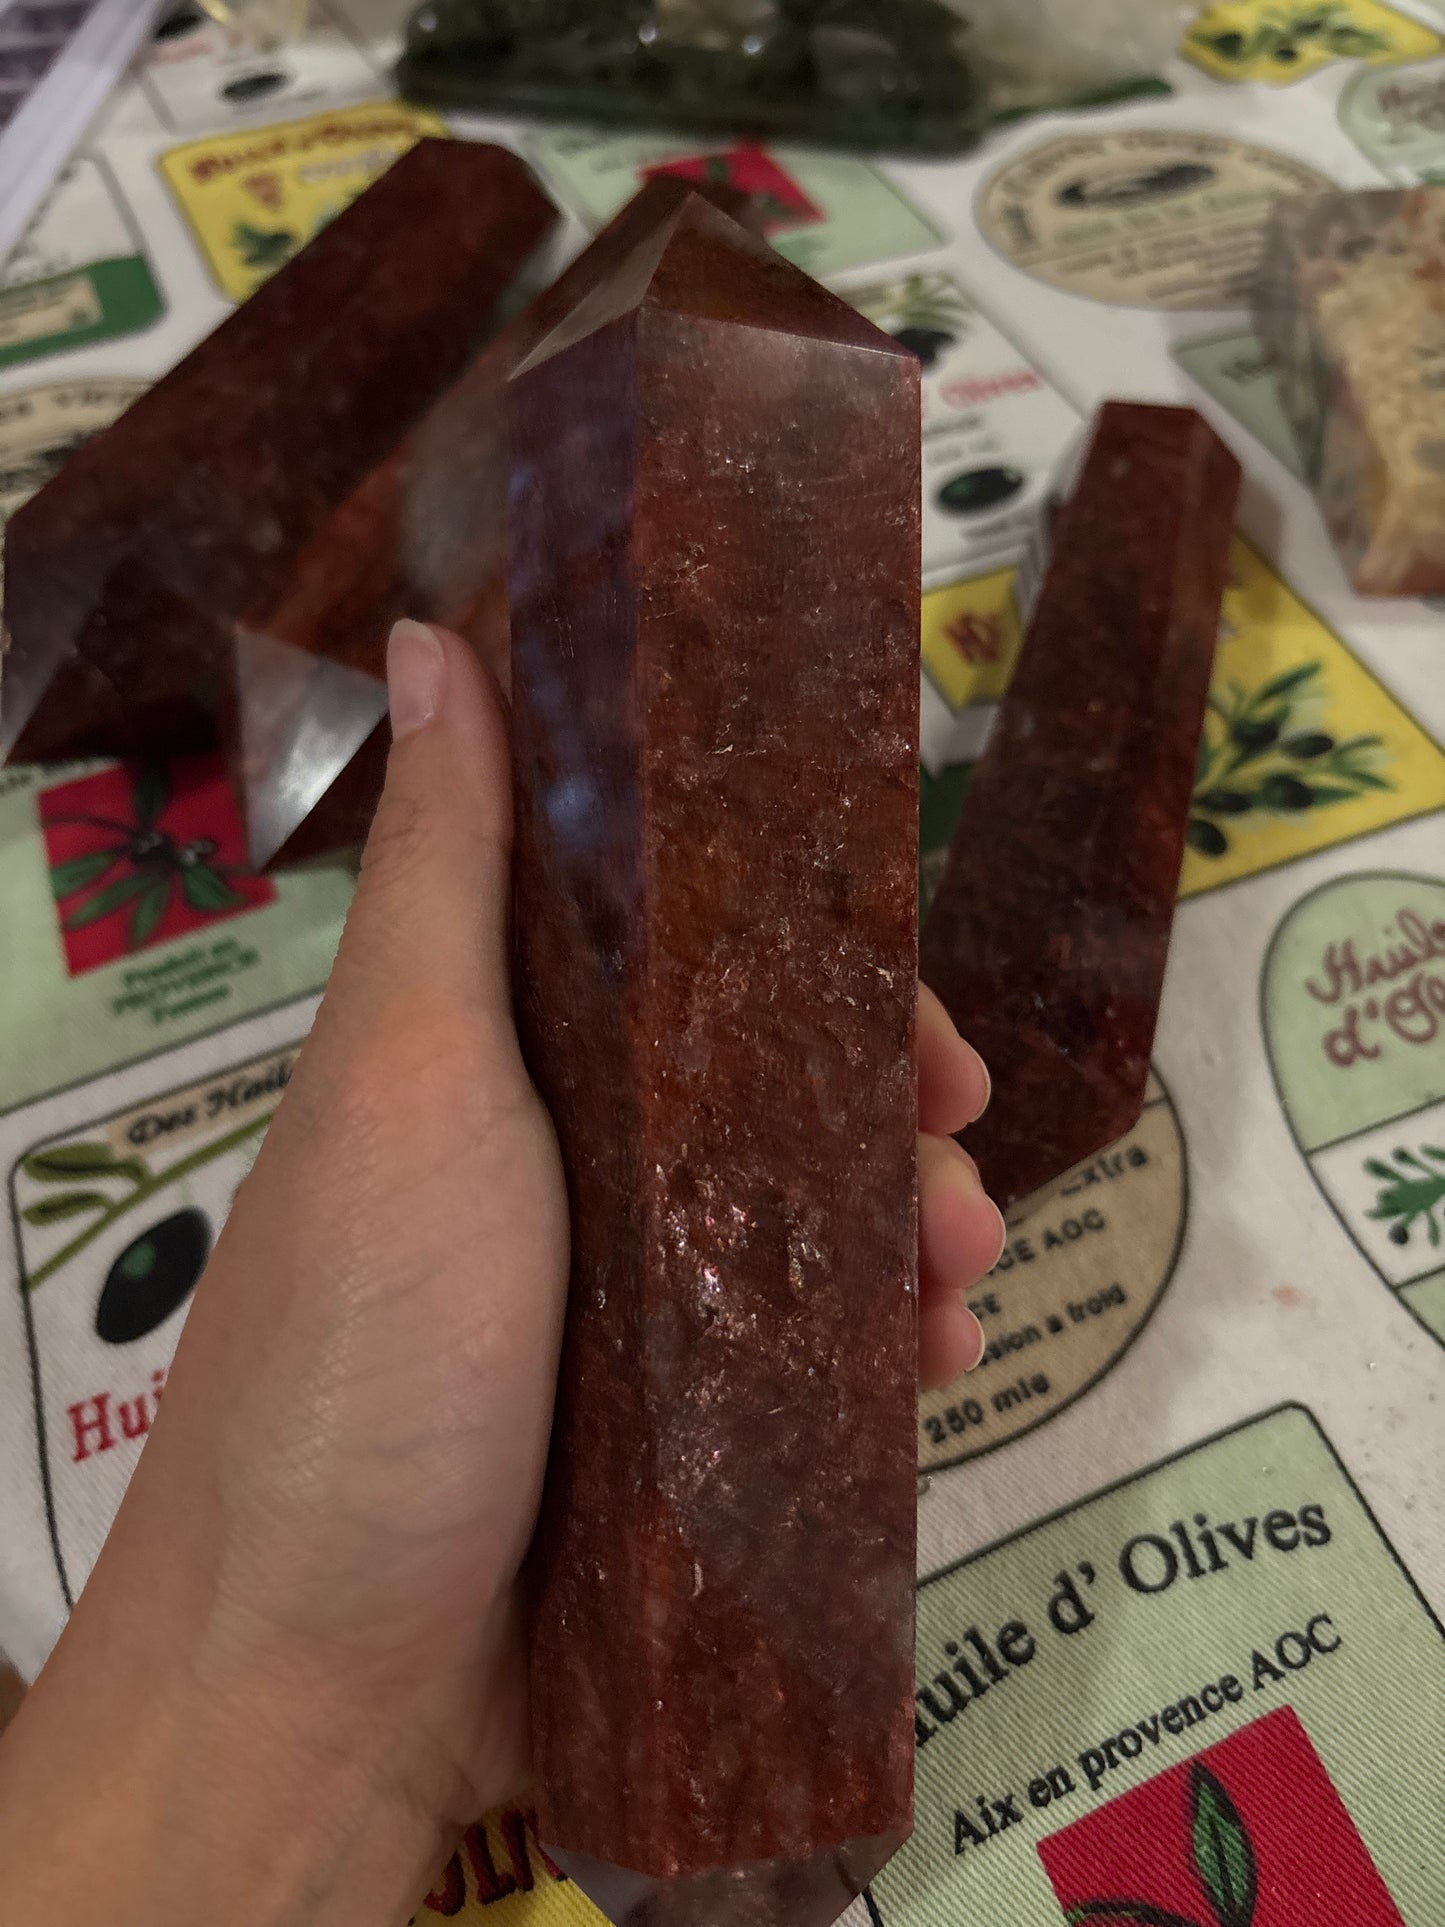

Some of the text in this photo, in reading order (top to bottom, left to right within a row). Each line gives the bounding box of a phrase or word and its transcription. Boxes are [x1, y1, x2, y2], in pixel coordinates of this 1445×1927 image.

[1060, 1145, 1148, 1196] xtra
[1043, 1208, 1105, 1250] AOC
[923, 1399, 984, 1445] 250
[1047, 1560, 1096, 1635] d'
[1118, 1503, 1333, 1594] Olives
[952, 1612, 1343, 1856] Aix en provence AOC
